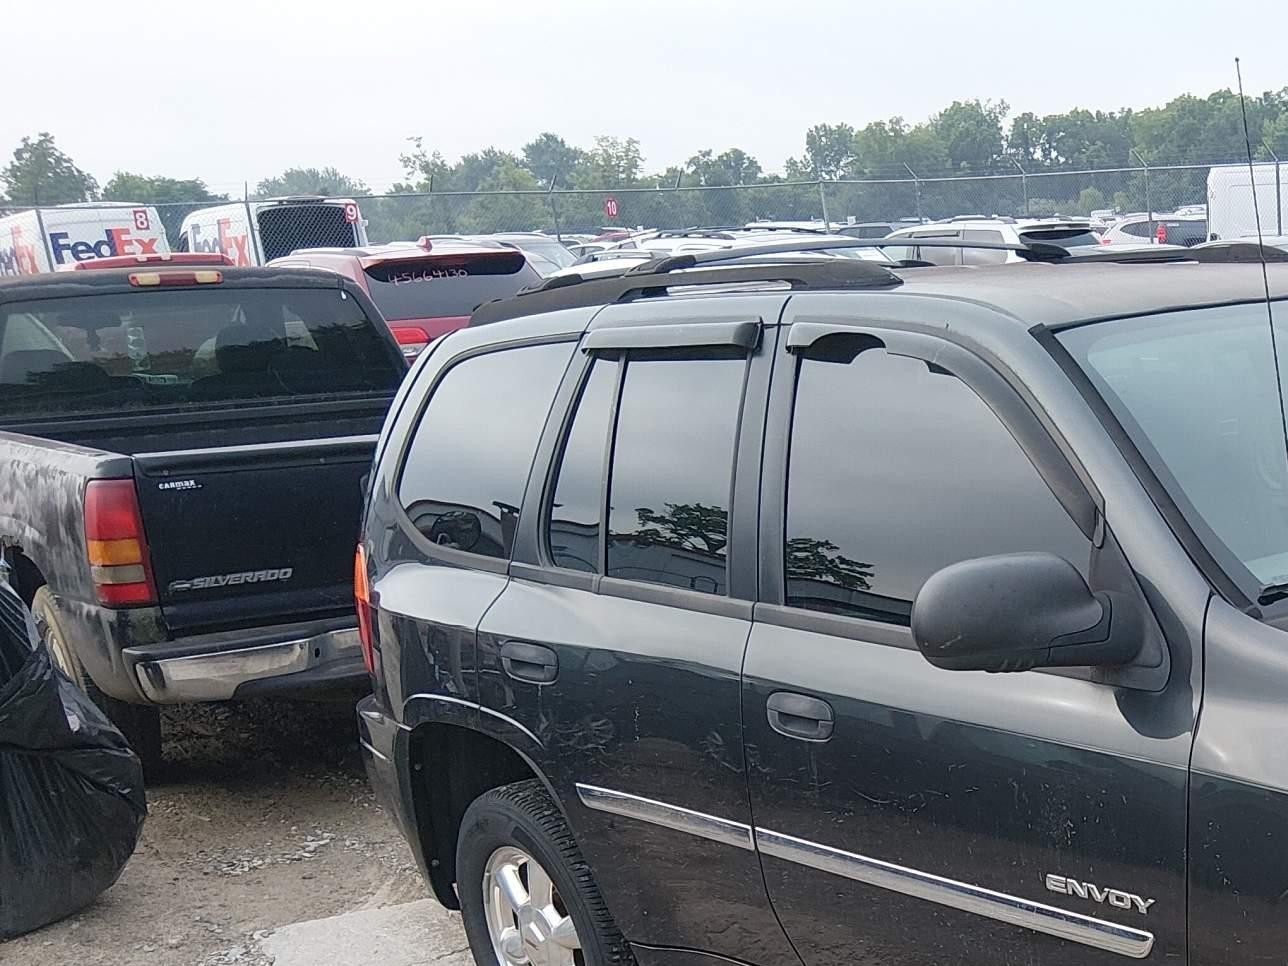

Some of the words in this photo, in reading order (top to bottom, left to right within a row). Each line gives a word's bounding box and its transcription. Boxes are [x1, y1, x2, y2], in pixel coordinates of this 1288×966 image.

[347, 204, 357, 219] 9
[607, 200, 617, 215] 10
[136, 212, 149, 229] 8
[49, 228, 159, 264] FedEx
[387, 267, 469, 286] 45664130
[193, 567, 294, 590] SILVERADO
[1046, 873, 1155, 914] ENVOY
